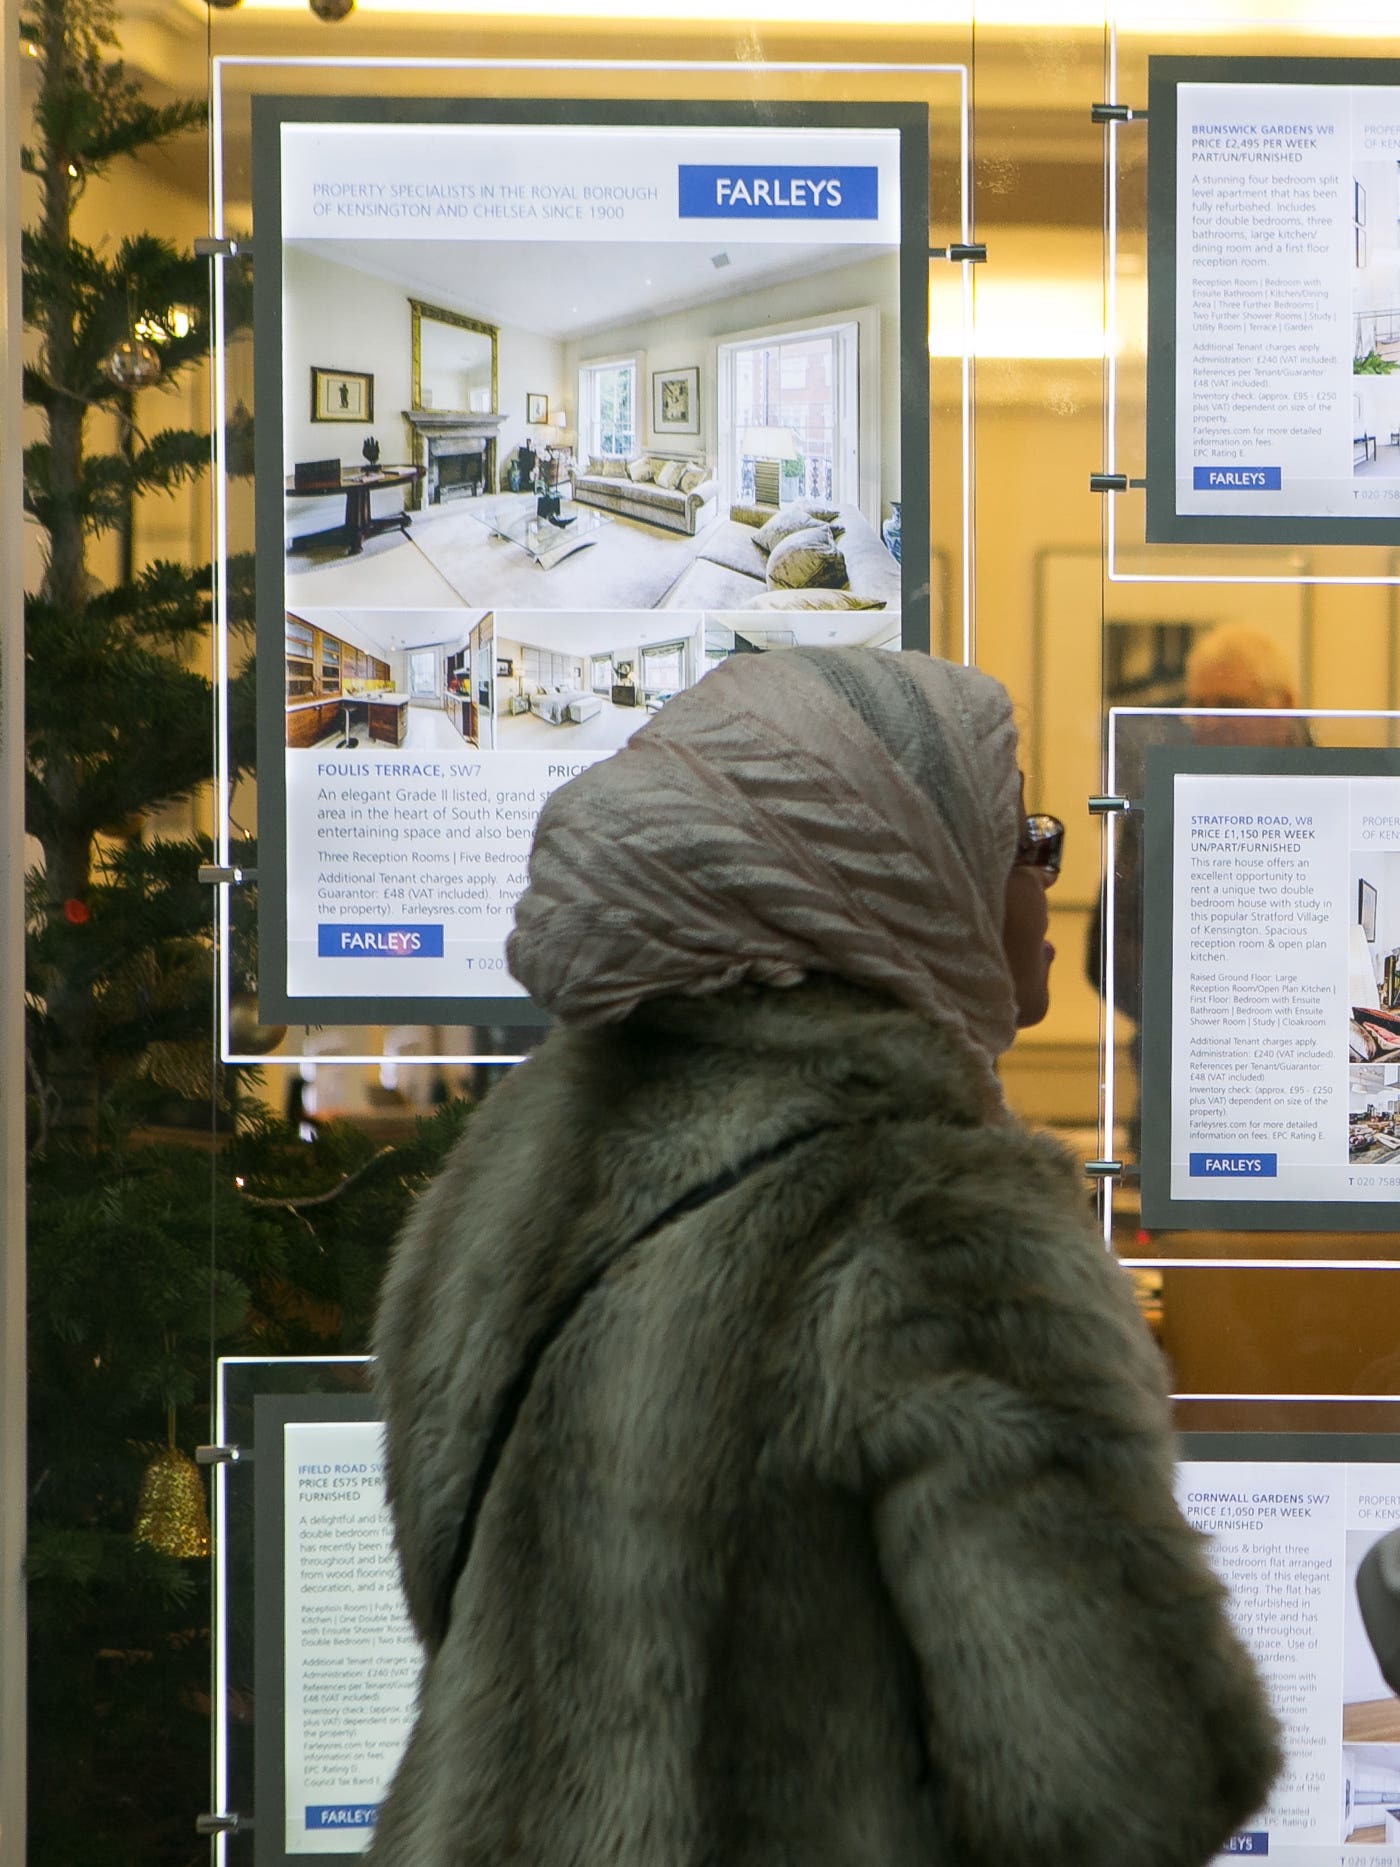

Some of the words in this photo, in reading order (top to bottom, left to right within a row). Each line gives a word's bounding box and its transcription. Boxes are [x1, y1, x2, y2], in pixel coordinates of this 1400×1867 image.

[1192, 125, 1257, 134] BRUNSWICK
[1261, 125, 1313, 135] GARDENS
[1316, 125, 1334, 134] W8
[1192, 138, 1221, 148] PRICE
[1225, 138, 1260, 149] £2,495
[1263, 138, 1282, 149] PER
[1285, 139, 1317, 149] WEEK
[1192, 152, 1303, 162] PART/UN/FURNISHED
[313, 183, 385, 197] PROPERTY
[390, 184, 475, 198] SPECIALISTS
[480, 184, 495, 199] IN
[499, 184, 525, 199] THE
[531, 185, 576, 200] ROYAL
[583, 186, 658, 200] BOROUGH
[716, 178, 842, 207] FARLEYS
[313, 202, 332, 216] OF
[337, 202, 431, 217] KENSINGTON
[436, 203, 468, 218] AND
[473, 203, 537, 218] CHELSEA
[542, 204, 582, 219] SINCE
[591, 205, 624, 219] 1900
[1210, 472, 1265, 485] FARLEYS
[318, 764, 369, 776] FOULIS
[450, 765, 481, 776] SW7
[317, 788, 336, 800] An
[341, 788, 391, 804] elegant
[396, 788, 437, 801] Grade
[496, 789, 535, 806] grand
[317, 809, 346, 819] area
[351, 809, 362, 819] in
[367, 807, 389, 820] the
[394, 807, 428, 820] heart
[433, 807, 446, 820] of
[452, 807, 490, 820] South
[496, 808, 540, 820] Kensin
[1191, 815, 1254, 825] STRATFORD
[1295, 816, 1313, 825] W8
[317, 825, 399, 841] entertaining
[403, 828, 441, 841] space
[445, 826, 471, 839] and
[475, 826, 502, 839] also
[1191, 829, 1220, 839] PRICE
[1224, 829, 1259, 840] £1,150
[1262, 829, 1281, 839] PER
[1283, 829, 1315, 839] WEEK
[1191, 843, 1301, 853] UN/PART/FURNISHED
[318, 851, 349, 862] Three
[353, 851, 408, 864] Reception
[412, 852, 450, 863] Rooms
[460, 852, 481, 863] Five
[1191, 857, 1210, 867] This
[1212, 859, 1232, 867] rare
[1234, 857, 1264, 868] house
[1267, 857, 1295, 868] offers
[1297, 860, 1309, 868] an
[318, 872, 375, 884] Additional
[379, 872, 416, 884] Tenant
[420, 872, 463, 886] charges
[1190, 871, 1233, 881] excellent
[1236, 872, 1293, 883] opportunity
[1296, 872, 1306, 881] to
[384, 888, 405, 899] £48
[408, 888, 434, 900] (VAT
[1191, 885, 1210, 894] rent
[1213, 886, 1219, 894] a
[1222, 885, 1255, 896] unique
[1258, 886, 1278, 894] two
[1280, 884, 1314, 895] double
[318, 903, 336, 914] the
[401, 903, 482, 917] Farleysres.com
[486, 903, 502, 915] for
[1190, 898, 1235, 908] bedroom
[1237, 898, 1267, 908] house
[1269, 898, 1291, 908] with
[1294, 898, 1321, 911] study
[1190, 911, 1208, 921] this
[1210, 911, 1248, 923] popular
[1251, 911, 1294, 922] Stratford
[1296, 911, 1329, 924] Village
[1190, 924, 1200, 935] of
[1265, 925, 1308, 937] Spacious
[341, 932, 421, 951] FARLEYS
[1190, 939, 1236, 951] reception
[1267, 939, 1275, 949] &
[1278, 941, 1303, 951] open
[1306, 939, 1327, 950] plan
[466, 958, 474, 969] T
[479, 957, 505, 969] 020
[1206, 1159, 1261, 1171] FARLEYS
[298, 1464, 332, 1474] IFIELD
[334, 1464, 368, 1474] ROAD
[299, 1478, 328, 1488] PRICE
[333, 1477, 358, 1488] £575
[299, 1491, 361, 1502] FURNISHED
[1187, 1493, 1248, 1503] CORNWALL
[1252, 1494, 1304, 1504] GARDENS
[1307, 1495, 1330, 1504] SW7
[1187, 1506, 1216, 1516] PRICE
[1220, 1506, 1255, 1518] £1,050
[1258, 1507, 1277, 1517] PER
[1280, 1508, 1311, 1517] WEEK
[1222, 1556, 1267, 1567] bedroom
[1270, 1556, 1285, 1568] flat
[1288, 1558, 1332, 1570] arranged
